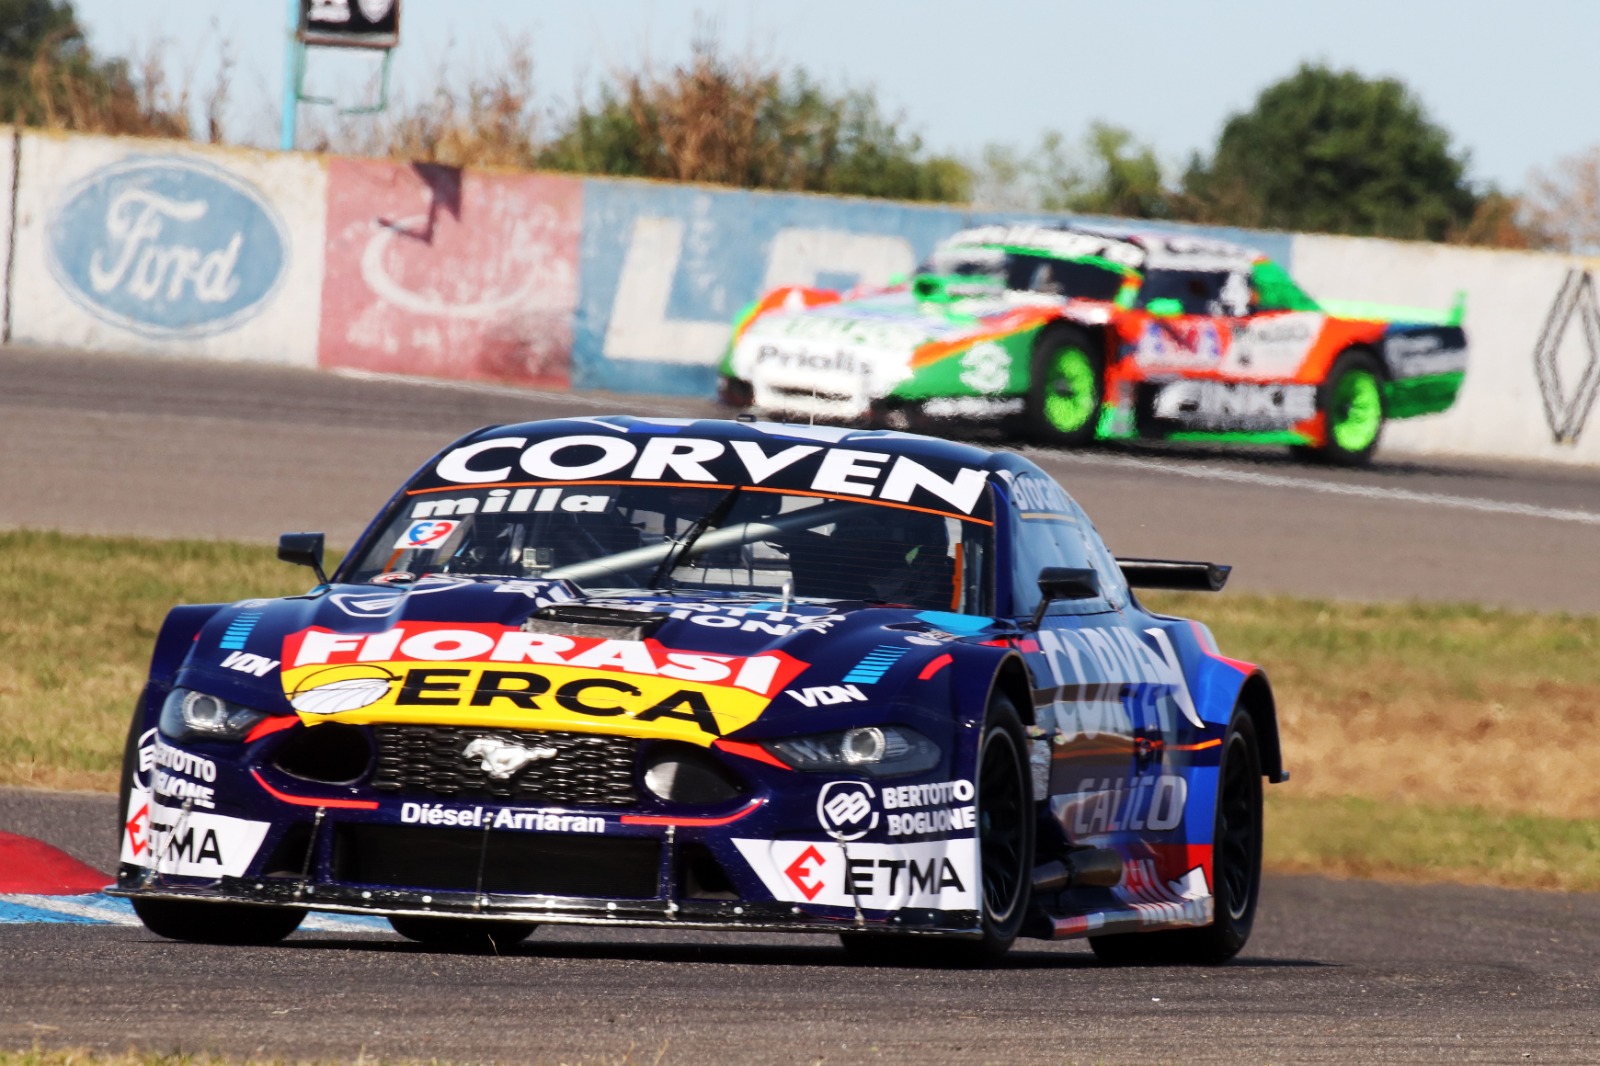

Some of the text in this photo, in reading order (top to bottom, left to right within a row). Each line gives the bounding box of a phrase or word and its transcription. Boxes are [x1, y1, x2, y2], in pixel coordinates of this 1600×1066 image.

[89, 188, 245, 302] Ford
[435, 434, 990, 515] CORVEN
[411, 488, 610, 518] milla
[219, 651, 281, 678] VDN
[294, 628, 781, 695] FIORASI
[395, 668, 723, 736] ERCA
[784, 684, 869, 708] VDN
[155, 742, 217, 783] TOTTO
[882, 779, 976, 810] BERTOTTO
[1074, 775, 1188, 835] CALICO
[401, 802, 606, 833] Diésel Arriaran
[886, 805, 977, 836] BOGLIONE
[843, 857, 967, 897] ETMA
